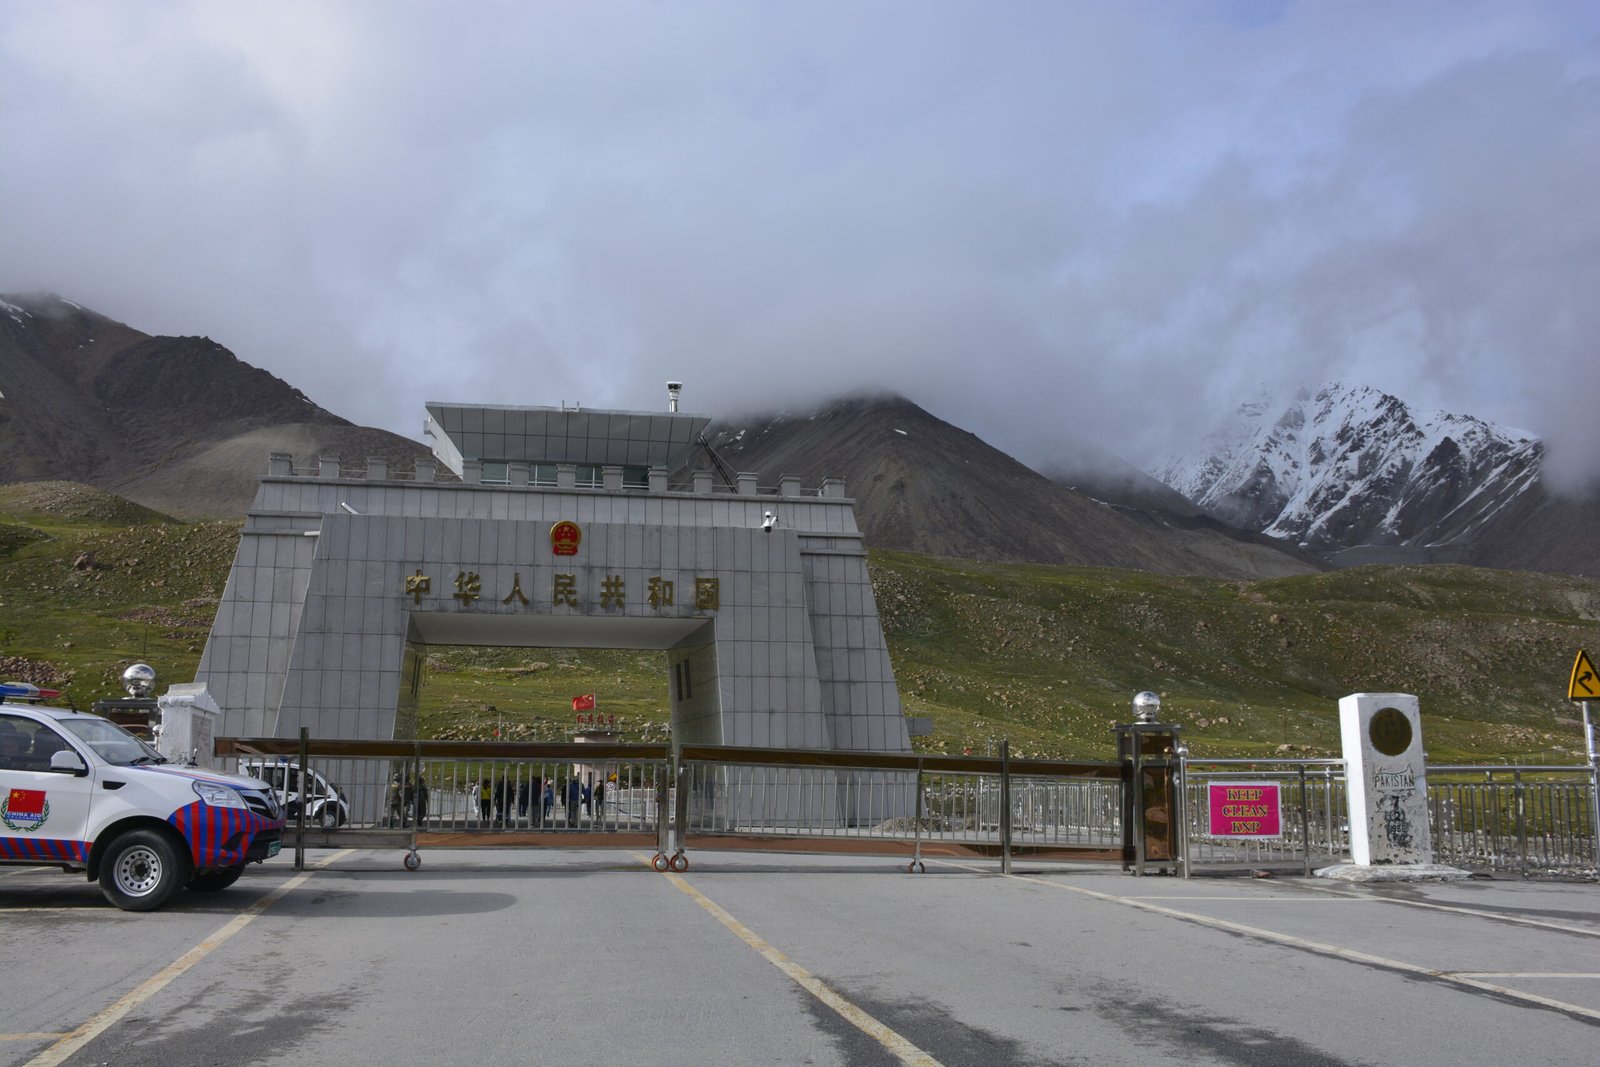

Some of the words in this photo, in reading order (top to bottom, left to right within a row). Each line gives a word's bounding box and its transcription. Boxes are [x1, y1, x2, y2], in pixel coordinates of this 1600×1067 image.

[405, 569, 721, 611] 中华人民共和国
[1374, 775, 1415, 788] PAKISTAN
[1227, 789, 1263, 800] KEEP
[1222, 805, 1269, 817] CLEAN
[1231, 821, 1261, 833] KNP
